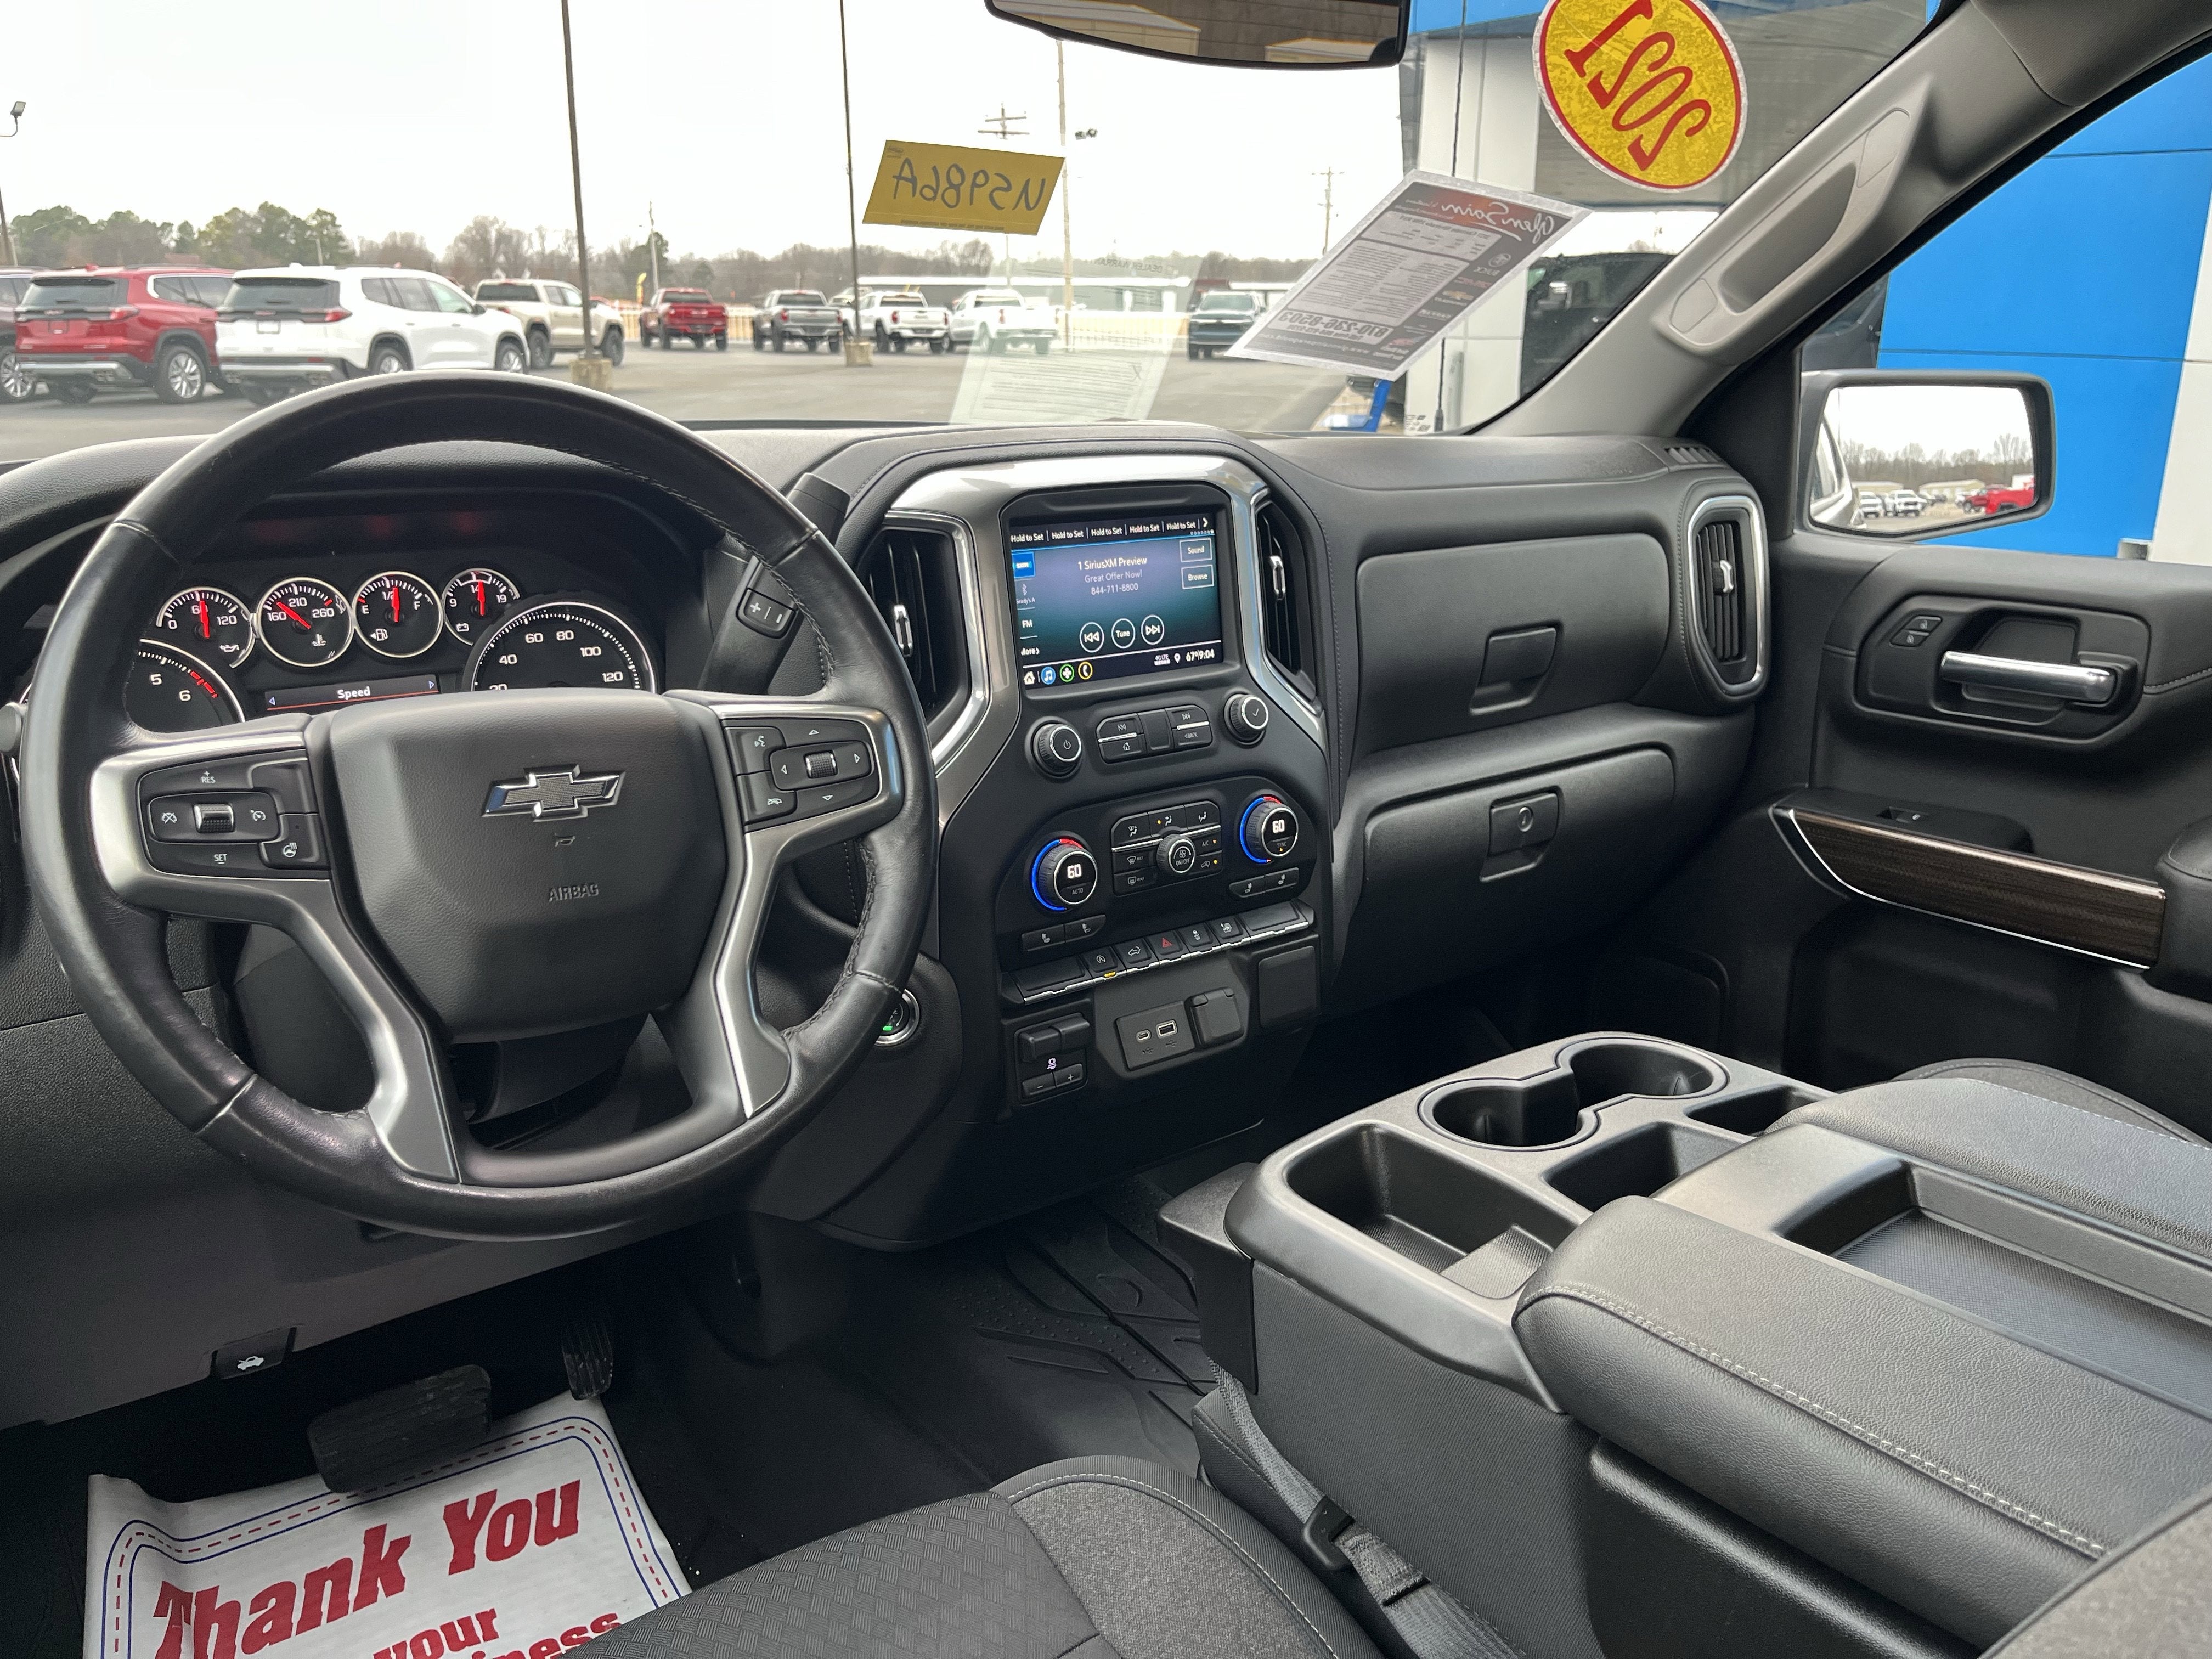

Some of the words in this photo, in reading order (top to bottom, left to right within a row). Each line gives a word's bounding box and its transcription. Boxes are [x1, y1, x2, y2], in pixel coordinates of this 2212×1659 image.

[1129, 525, 1142, 533] Hold
[1166, 522, 1179, 531] Hold
[1051, 531, 1065, 539] Hold
[1091, 528, 1105, 536] Hold
[1011, 534, 1025, 543] Hold
[1187, 545, 1205, 554] Sound
[1078, 561, 1082, 571] 1
[1085, 558, 1117, 570] SiriusXM
[1119, 557, 1147, 567] Preview
[1085, 574, 1104, 583] Great
[1105, 572, 1124, 581] Offer
[1125, 569, 1142, 579] Now!
[1188, 573, 1208, 581] Browse
[1091, 583, 1138, 595] 844-711-8800
[289, 597, 307, 607] 210
[449, 599, 457, 607] 9
[496, 594, 507, 603] 19
[362, 605, 370, 614] E
[414, 601, 421, 610] F
[267, 611, 287, 622] 160
[312, 608, 335, 618] 260
[168, 620, 177, 629] 0
[217, 614, 237, 625] 120
[1022, 619, 1033, 628] FM
[525, 633, 544, 643] 60
[556, 630, 574, 641] 80
[1115, 630, 1130, 638] Tune
[580, 646, 601, 657] 100
[1199, 648, 1215, 660] 9:04
[499, 654, 517, 665] 40
[150, 673, 162, 686] 5
[602, 672, 623, 682] 120
[179, 689, 191, 702] 6
[337, 685, 371, 700] Speed
[201, 775, 216, 783] RES
[1272, 819, 1285, 833] 60
[213, 853, 228, 862] SET
[1066, 864, 1082, 879] 60
[549, 883, 599, 902] AIRBAG
[152, 1523, 411, 1659] Thank
[442, 1480, 580, 1575] You
